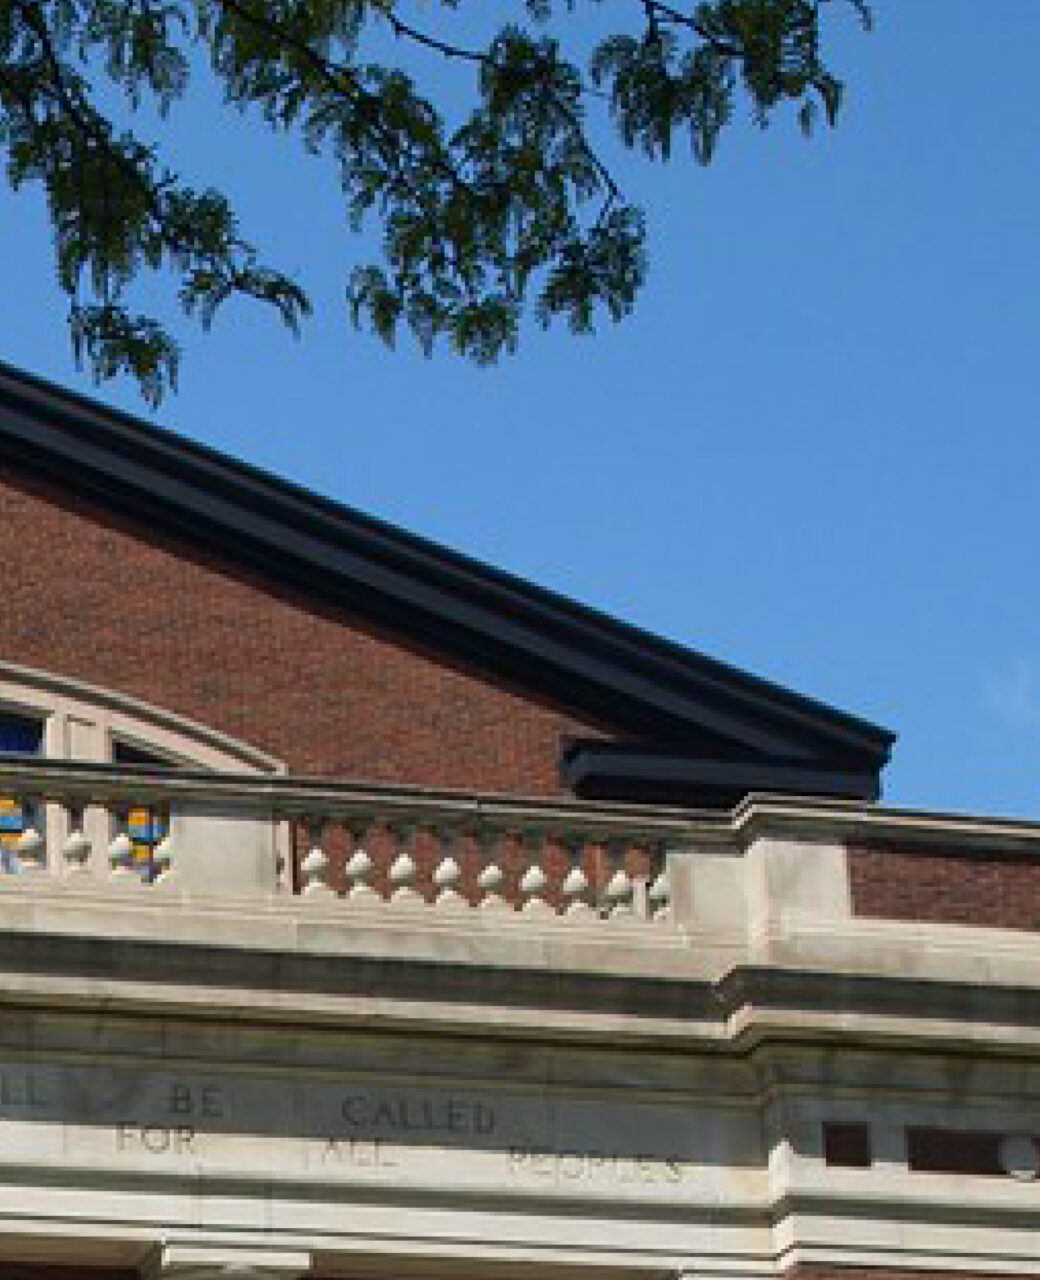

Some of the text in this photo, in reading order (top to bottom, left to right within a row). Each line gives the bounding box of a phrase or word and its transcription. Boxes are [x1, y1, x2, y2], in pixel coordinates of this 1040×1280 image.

[169, 1082, 226, 1119] BE
[341, 1095, 496, 1135] CALLED
[116, 1121, 197, 1155] FOR
[320, 1136, 400, 1168] ALL
